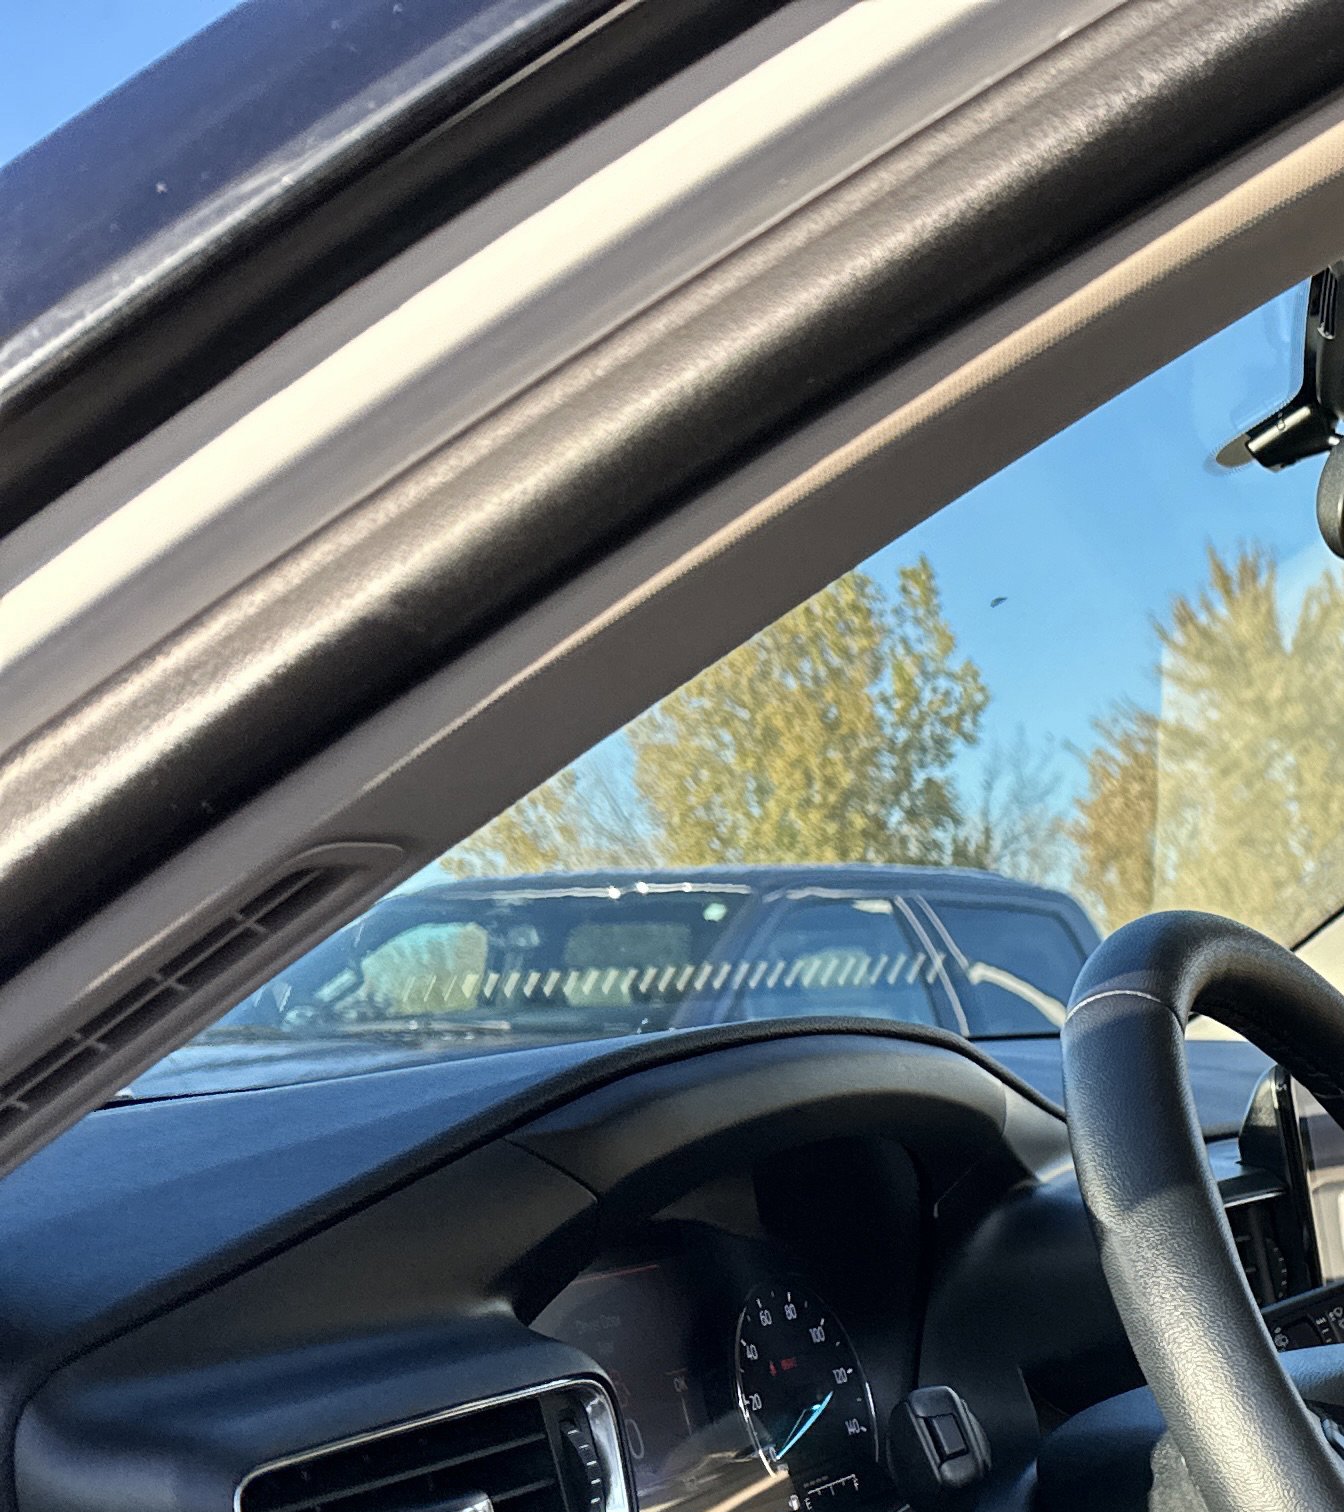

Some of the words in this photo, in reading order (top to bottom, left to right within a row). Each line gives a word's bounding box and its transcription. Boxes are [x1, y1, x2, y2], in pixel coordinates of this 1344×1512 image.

[759, 1310, 772, 1327] 60
[784, 1303, 797, 1320] 80
[809, 1326, 826, 1344] 100
[746, 1344, 759, 1361] 40
[832, 1367, 848, 1385] 120
[750, 1393, 763, 1411] 20
[845, 1418, 861, 1436] 140
